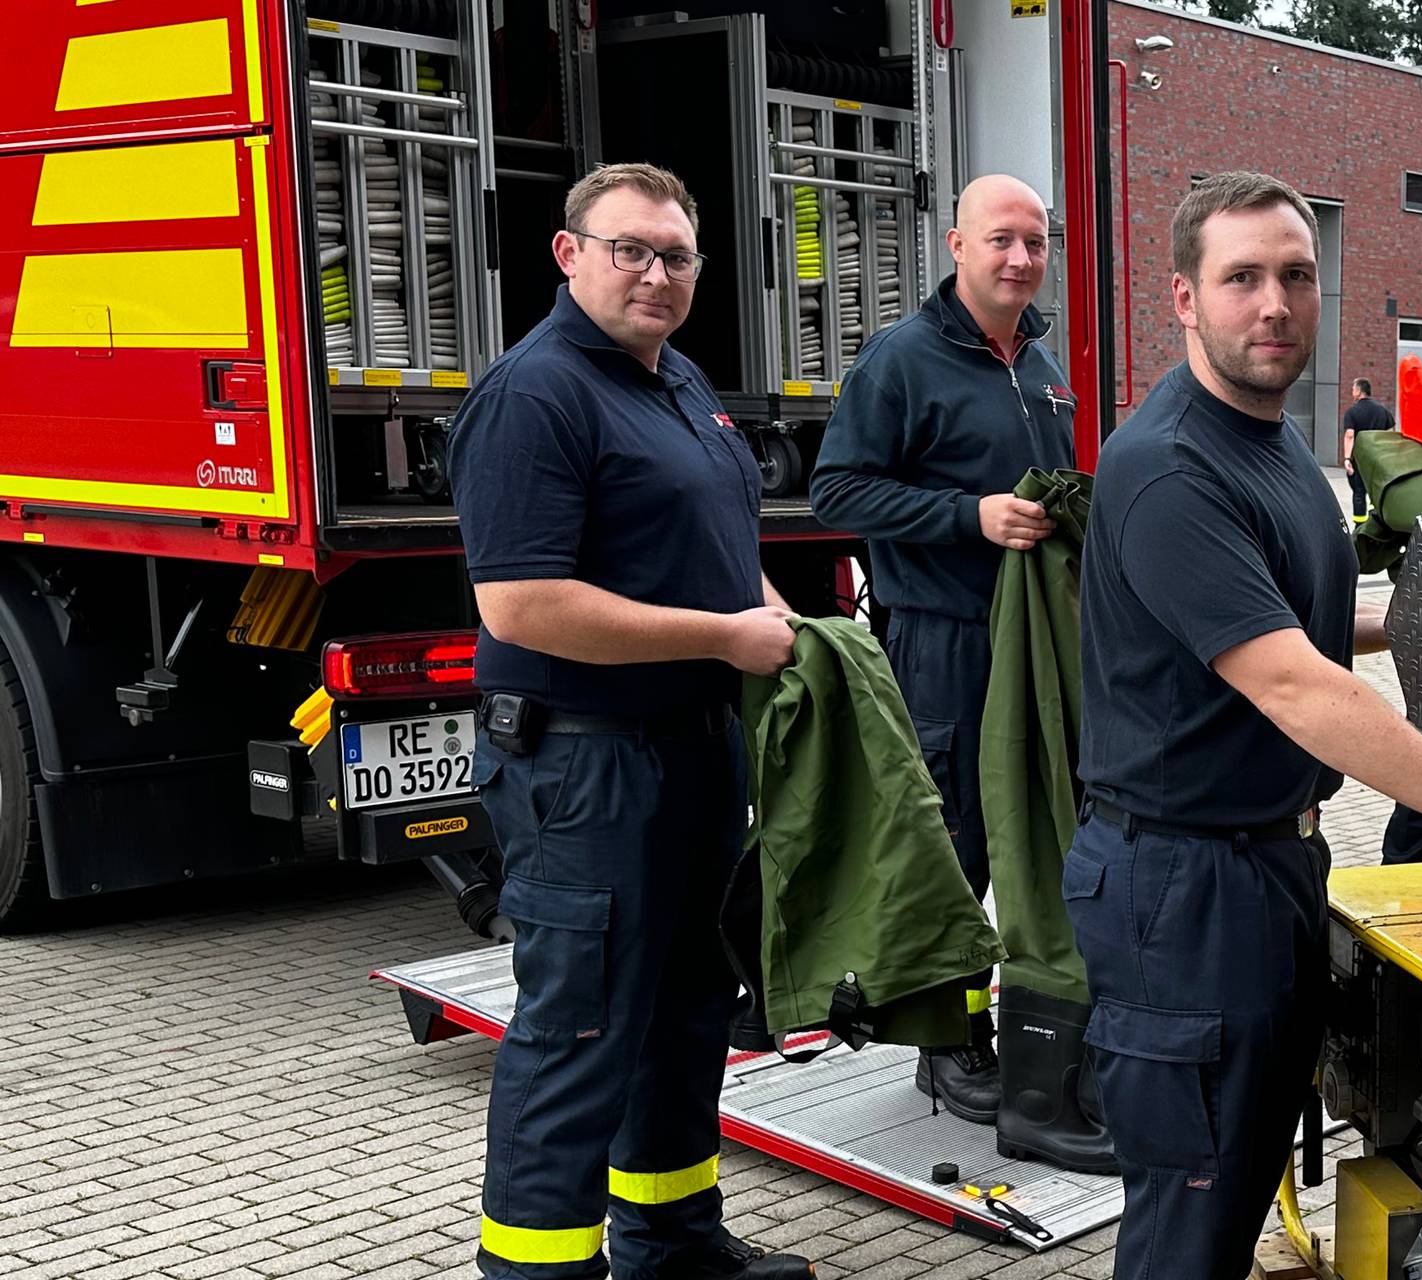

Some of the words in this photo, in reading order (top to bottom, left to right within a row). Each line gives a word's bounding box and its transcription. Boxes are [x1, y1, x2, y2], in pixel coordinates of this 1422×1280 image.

[218, 466, 257, 486] ITURRI
[389, 721, 433, 758] RE
[350, 749, 357, 759] D
[252, 772, 288, 789] PALFINGER
[354, 765, 392, 802] DO
[400, 755, 471, 796] 3592
[409, 818, 465, 837] PALFINGER
[1023, 1025, 1054, 1035] DUNLOP
